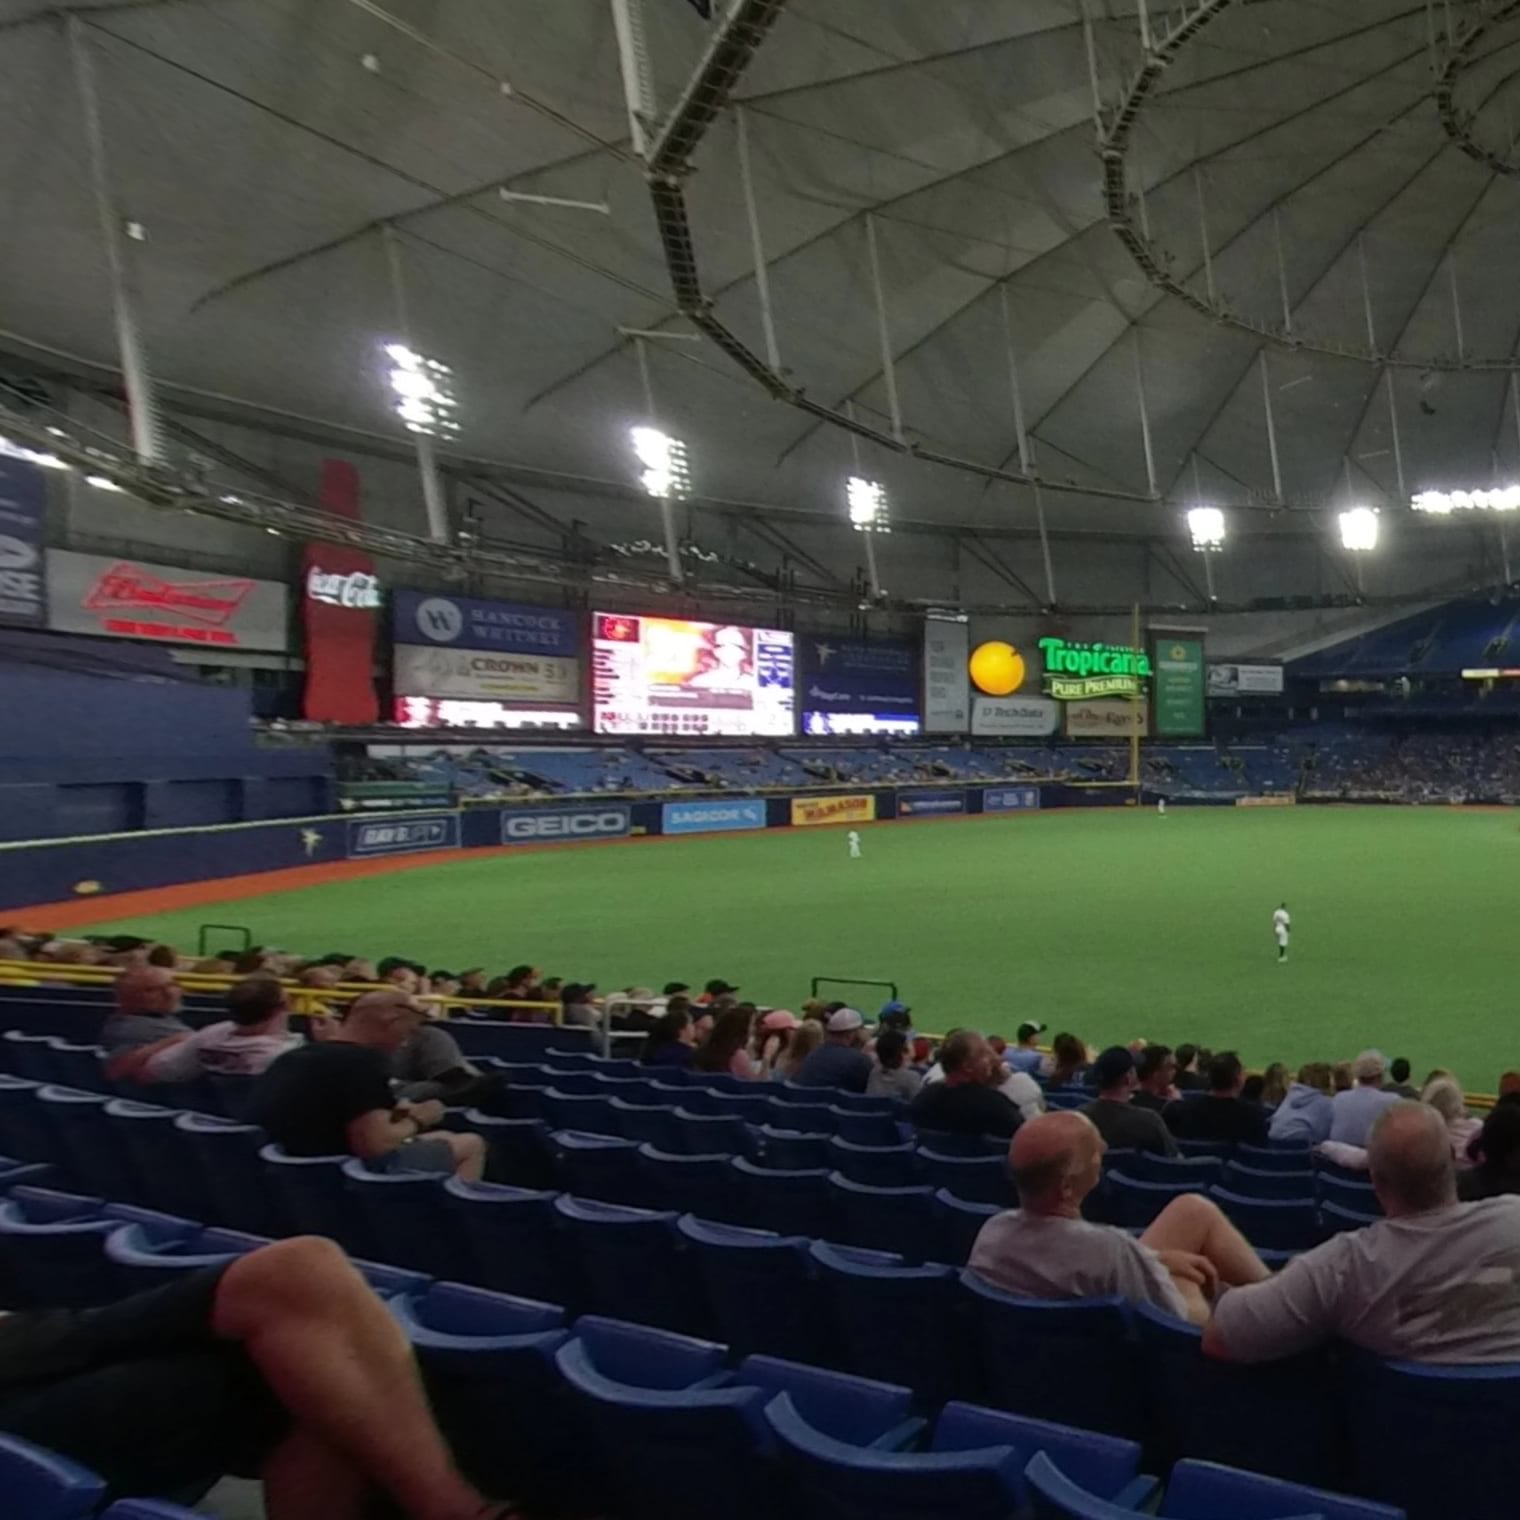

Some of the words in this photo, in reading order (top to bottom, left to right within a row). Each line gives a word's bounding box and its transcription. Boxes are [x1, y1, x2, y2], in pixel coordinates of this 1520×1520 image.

[471, 609, 561, 630] HANCOCK
[1039, 637, 1149, 676] Tropicana
[1052, 680, 1082, 695] PURE
[506, 812, 626, 837] GEICO
